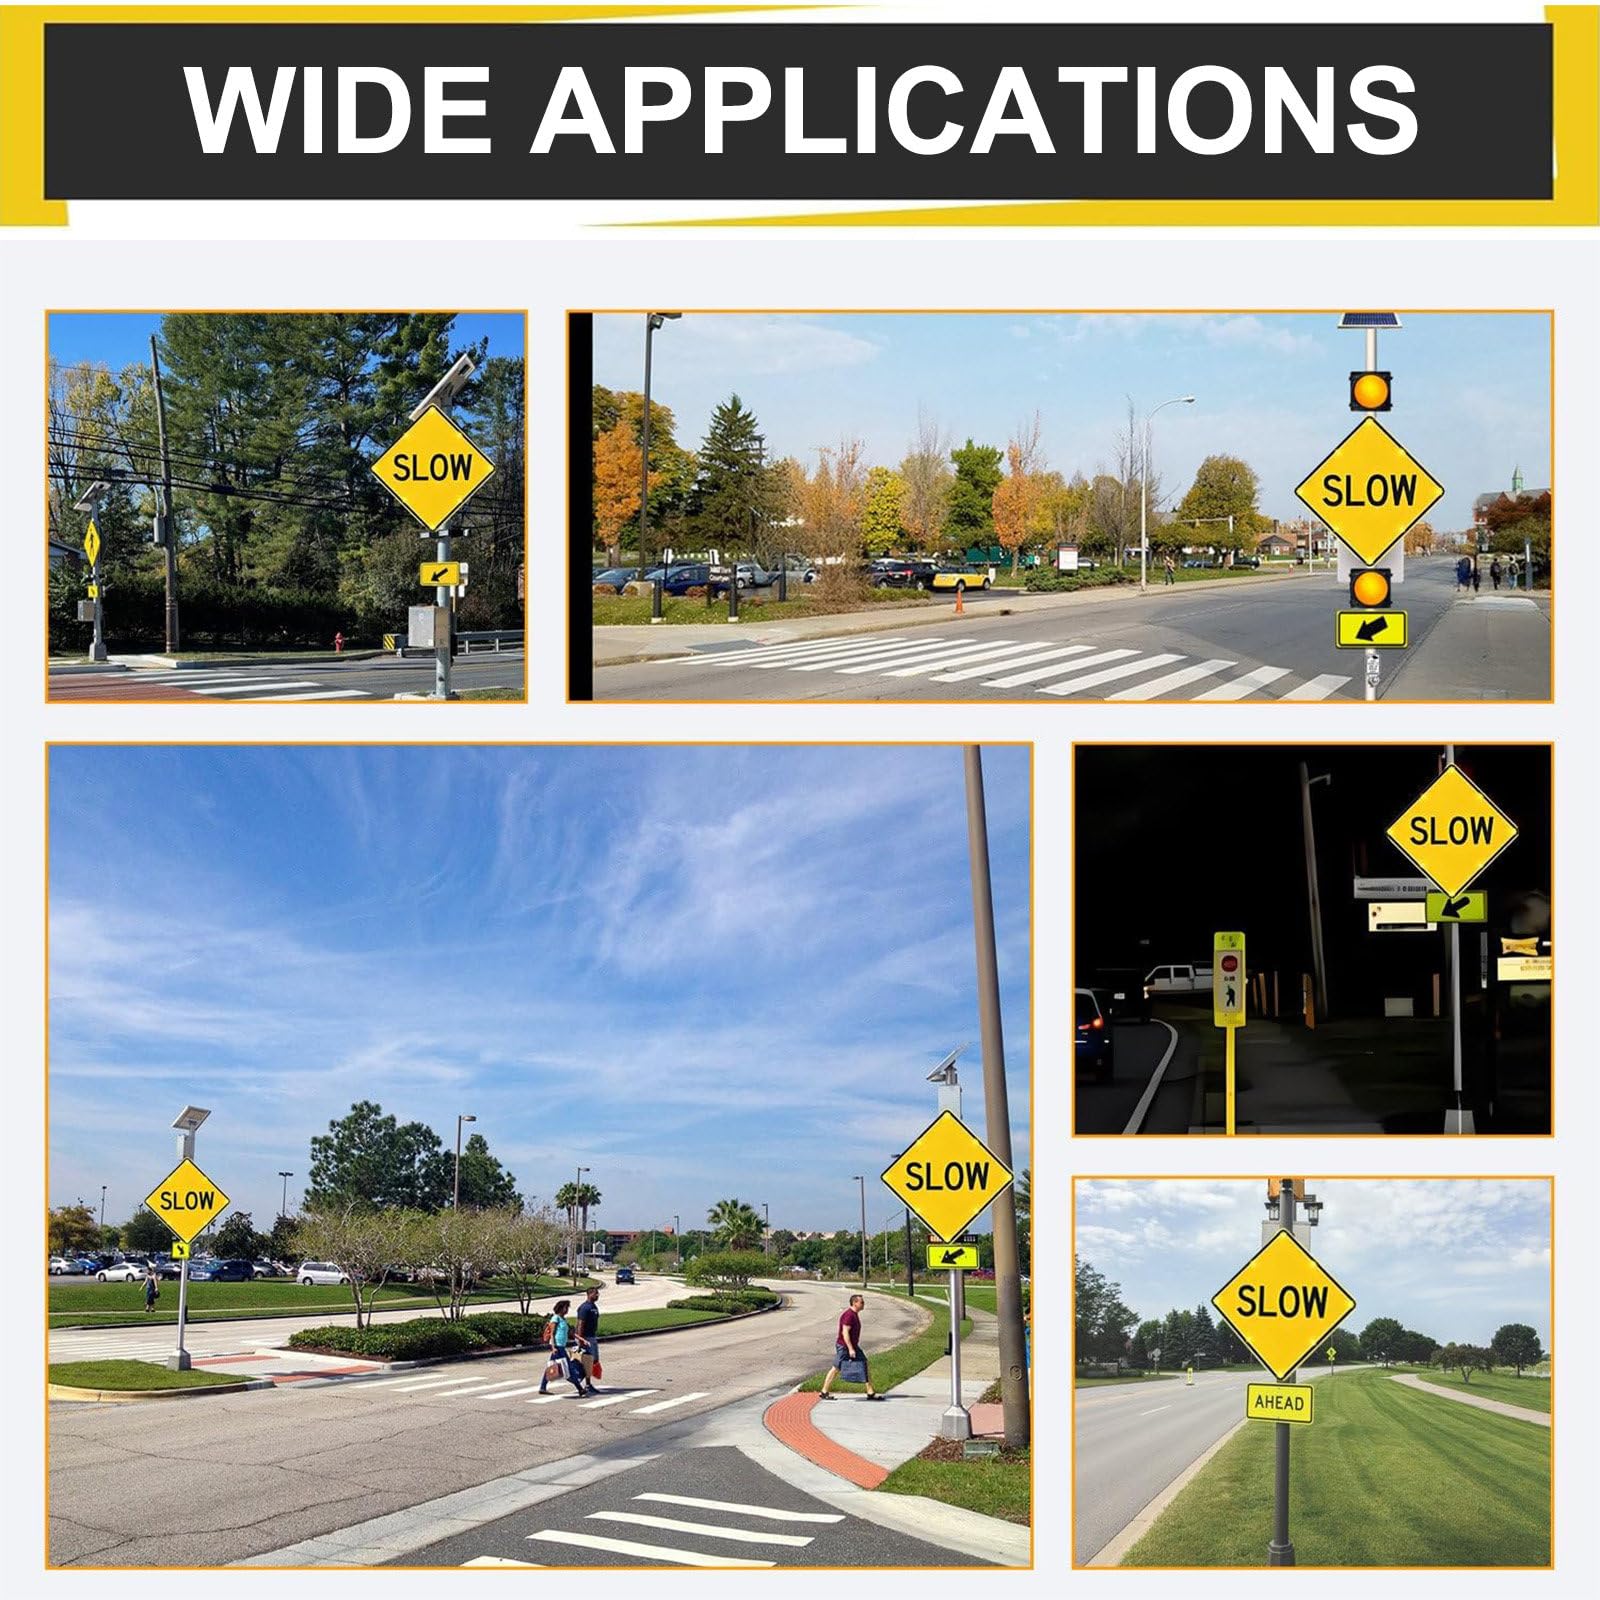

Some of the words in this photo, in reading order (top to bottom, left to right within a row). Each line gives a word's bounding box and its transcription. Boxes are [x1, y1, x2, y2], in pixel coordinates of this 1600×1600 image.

[393, 453, 473, 482] SLOW
[1322, 473, 1418, 507] SLOW
[1410, 815, 1494, 846] SLOW
[906, 1161, 990, 1191] SLOW
[160, 1191, 215, 1211] SLOW
[1236, 1284, 1329, 1319] SLOW
[1254, 1394, 1304, 1411] AHEAD
